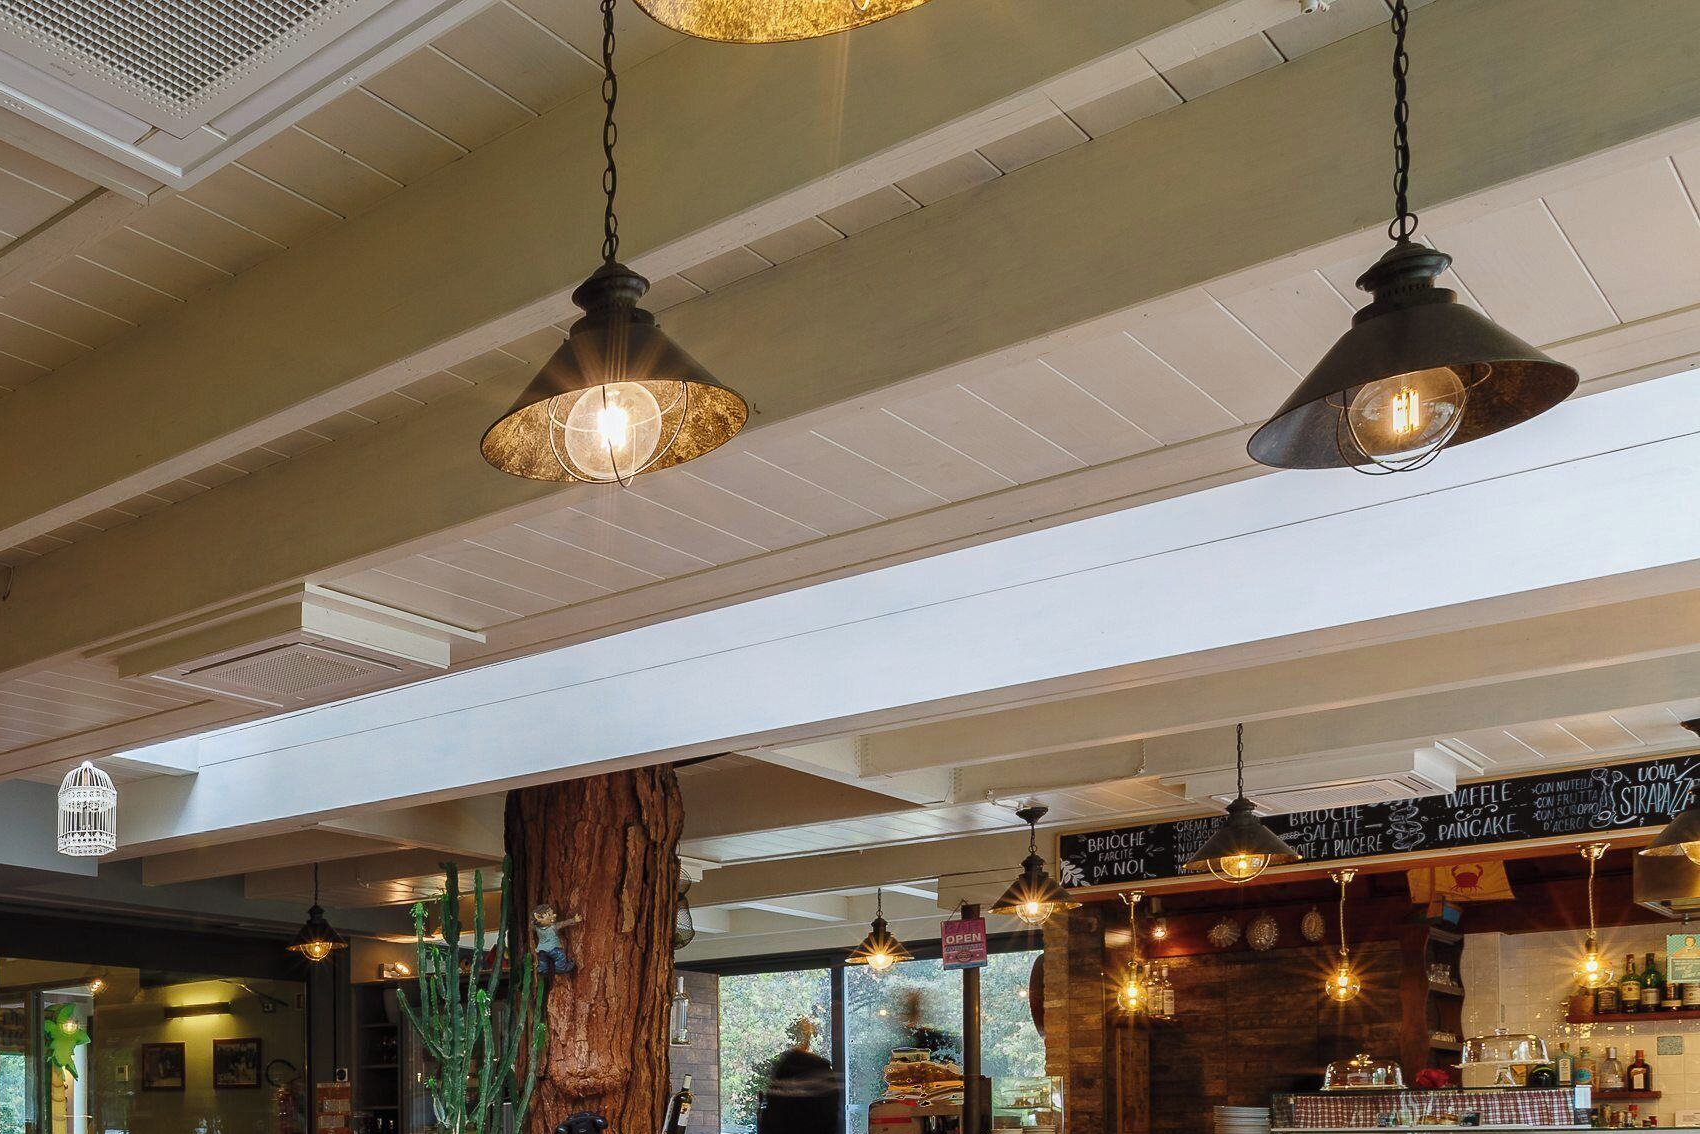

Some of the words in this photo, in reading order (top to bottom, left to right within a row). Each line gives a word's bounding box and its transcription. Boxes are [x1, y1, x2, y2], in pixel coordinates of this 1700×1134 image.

[1638, 764, 1676, 782] UOVA
[1556, 778, 1594, 791] NUTELLA
[1445, 782, 1512, 808] WAFFLE
[1557, 790, 1598, 806] FRUTTA
[1621, 778, 1700, 815] STRAPAZZA
[1176, 819, 1208, 832] CREMA
[1289, 806, 1364, 827] BRIOCHE
[1438, 813, 1517, 840] PANCAKE
[1303, 820, 1363, 842] SALATE
[1088, 830, 1147, 853] BRIOCHE
[1334, 834, 1383, 857] PIACERE
[1099, 849, 1133, 862] FARCITE
[1093, 865, 1108, 878] DA
[1113, 858, 1144, 875] NOI
[946, 932, 981, 944] OPEN
